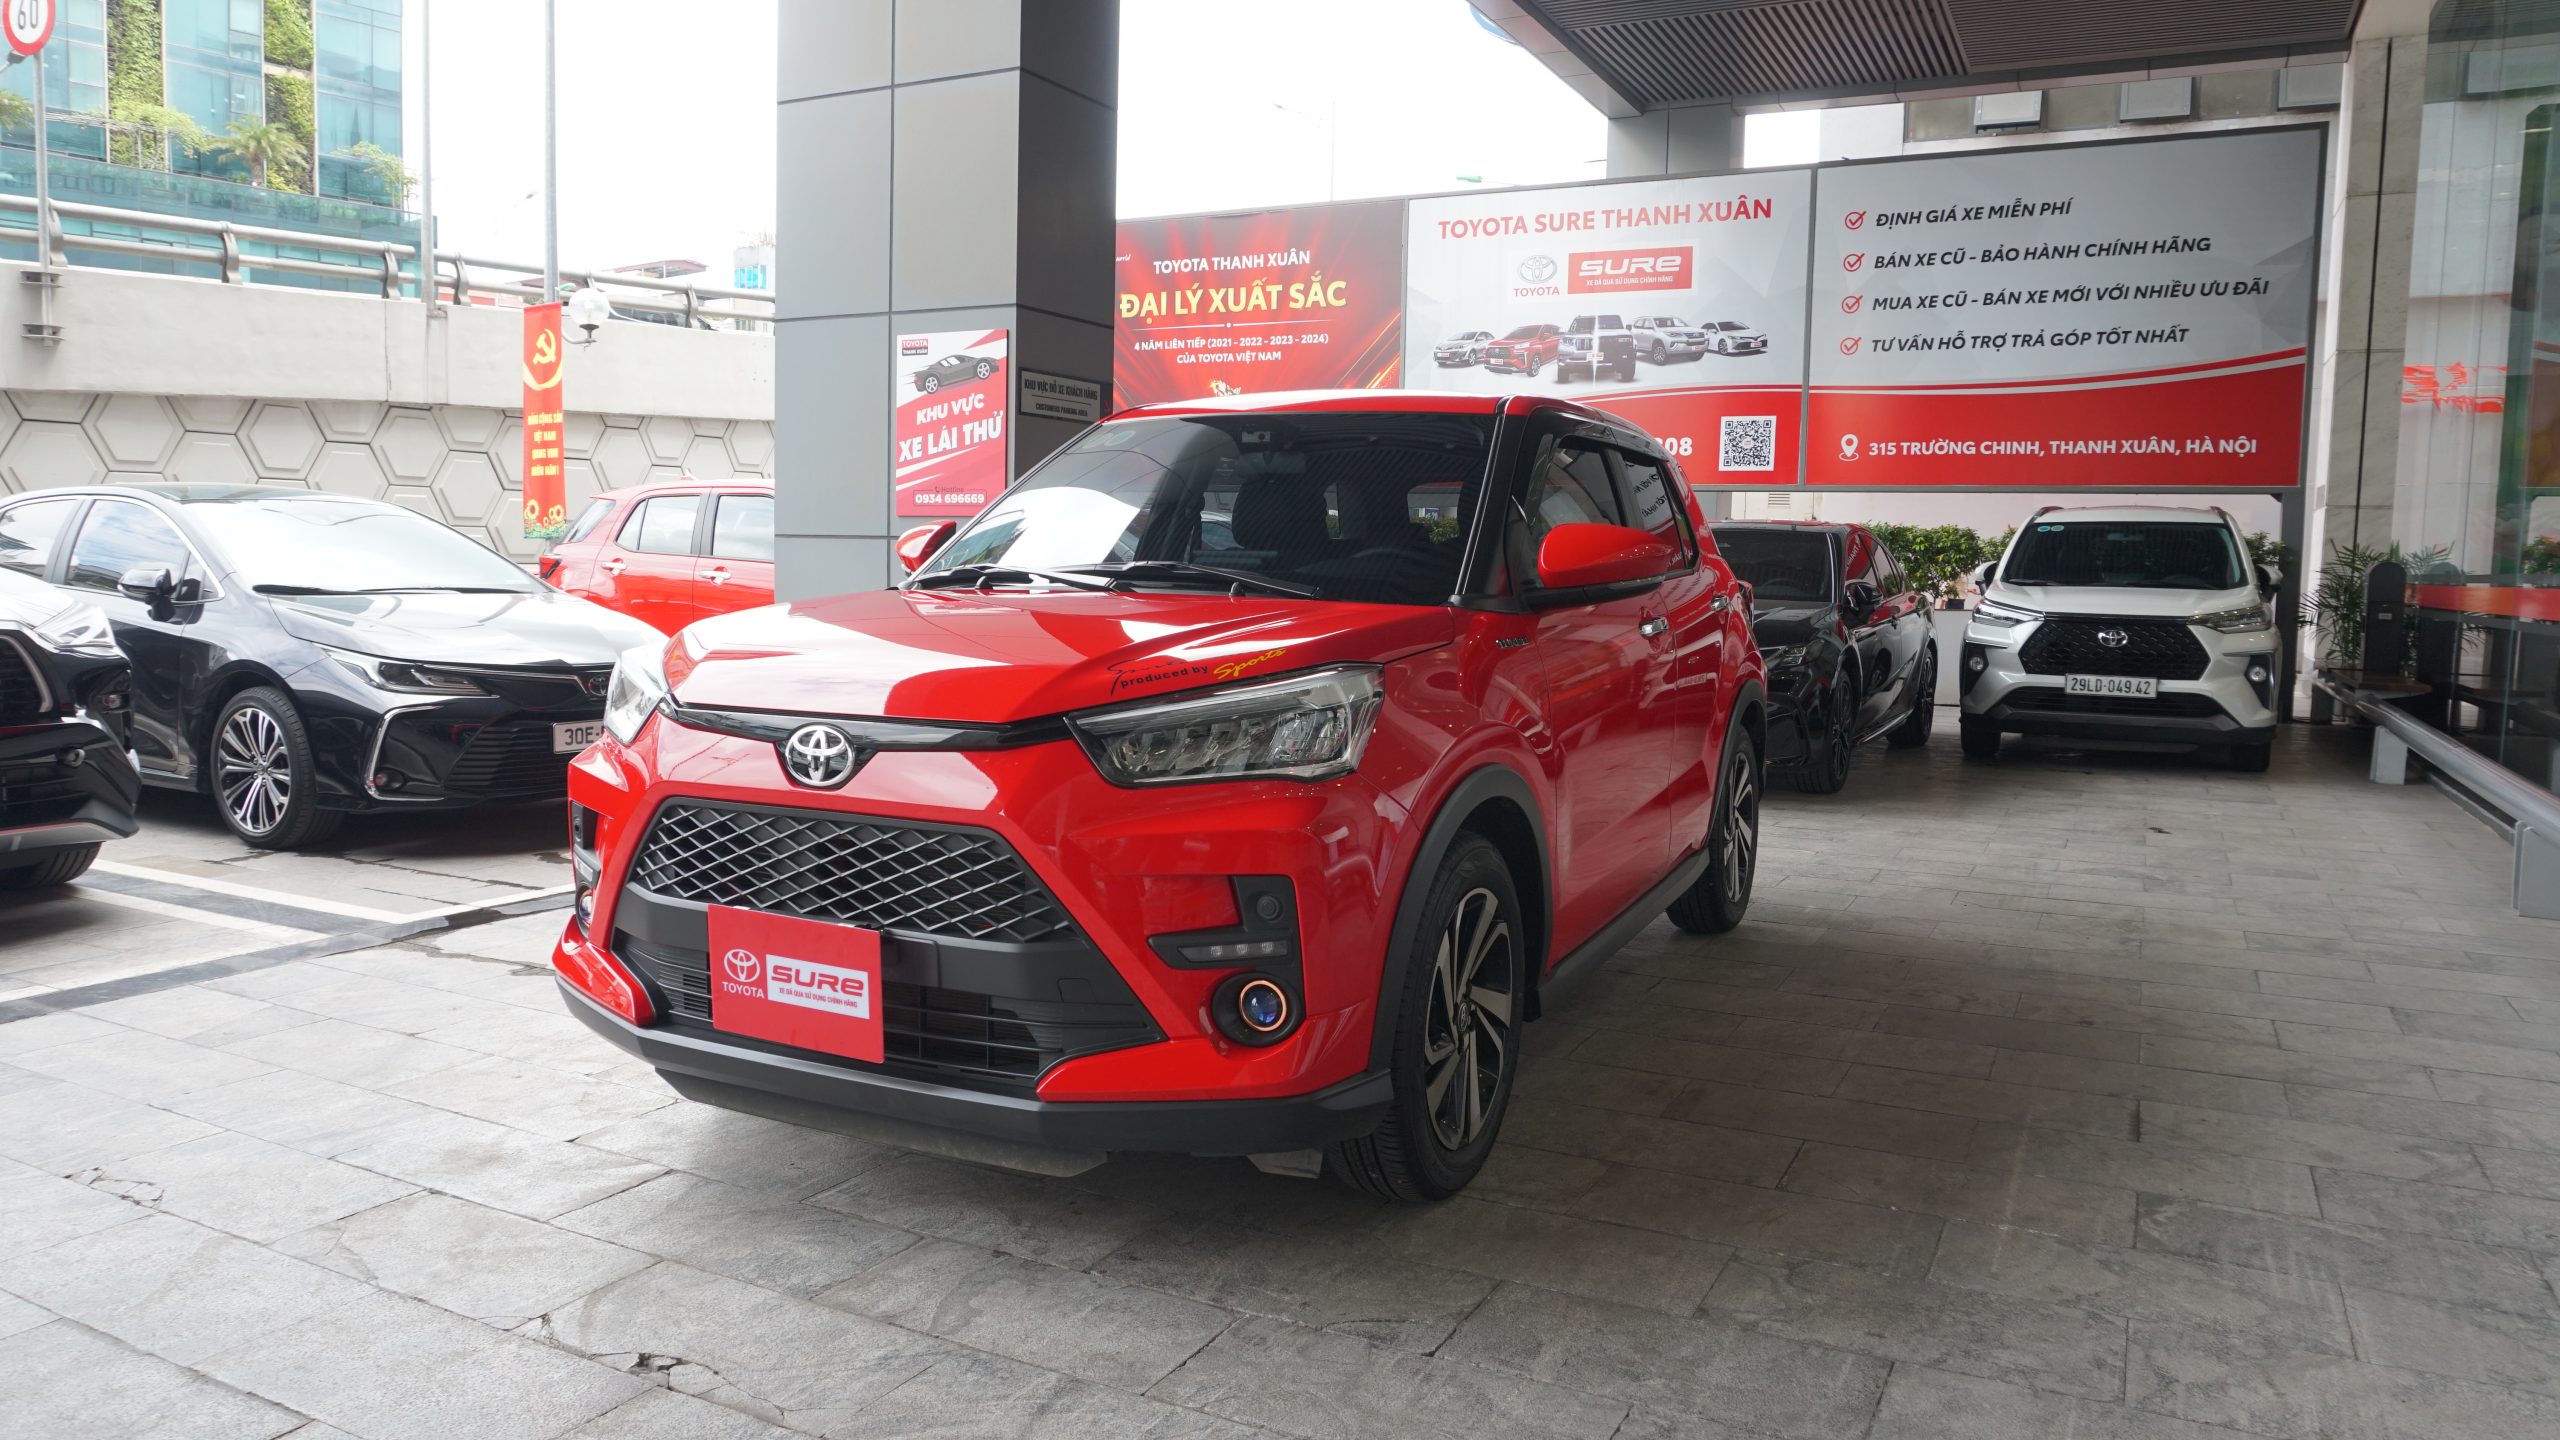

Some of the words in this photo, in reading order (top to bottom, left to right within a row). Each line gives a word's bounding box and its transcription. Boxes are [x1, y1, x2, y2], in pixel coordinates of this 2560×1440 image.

[18, 0, 39, 29] 60
[1438, 215, 1529, 239] TOYOTA
[1534, 209, 1596, 234] SURE
[1601, 204, 1691, 229] THANH
[1697, 194, 1773, 223] XUÂN
[1875, 209, 1921, 229] ĐỊNH
[1925, 204, 1959, 224] GIÁ
[1961, 204, 1985, 222] XE
[1988, 197, 2037, 220] MIỄN
[2040, 197, 2074, 217] PHÍ
[1153, 257, 1209, 275] TOYOTA
[1212, 253, 1264, 270] THANH
[1267, 248, 1311, 268] XUÂN
[1873, 249, 1912, 270] BÁN
[1914, 251, 1938, 268] XE
[1940, 245, 1967, 266] CŨ
[1980, 242, 2020, 264] BẢO
[2023, 239, 2081, 262] HÀNH
[2084, 236, 2148, 259] CHÍNH
[2151, 236, 2212, 255] HÃNG
[1120, 291, 1167, 324] ĐẠI
[1175, 282, 1204, 315] LÝ
[1208, 277, 1283, 313] XUẤT
[1289, 270, 1347, 309] SẮC
[1513, 286, 1560, 297] TOYOTA
[1872, 295, 1913, 312] MUA
[1916, 293, 1939, 309] XE
[1941, 287, 1969, 308] CŨ
[1982, 285, 2022, 306] BÁN
[2024, 289, 2049, 305] XE
[2052, 283, 2093, 303] MỚI
[2096, 281, 2130, 301] VỚI
[2133, 278, 2197, 299] NHIỀU
[2200, 279, 2231, 297] ƯU
[2232, 278, 2270, 296] ĐÃI
[902, 339, 928, 348] TOYOTA
[1134, 341, 1140, 351] 4
[1141, 338, 1163, 350] NĂM
[1164, 337, 1185, 350] LIÊN
[1185, 335, 1206, 349] TIẾP
[1207, 336, 1232, 349] (2021
[1240, 336, 1263, 347] 2022
[1270, 334, 1293, 345] 2023
[1301, 333, 1329, 345] 2024)
[1872, 335, 1897, 353] TƯ
[1897, 329, 1934, 352] VẤN
[1937, 328, 1967, 350] HỖ
[1970, 333, 2007, 352] TRỢ
[2011, 329, 2047, 349] TRẢ
[2050, 327, 2093, 347] GÓP
[2095, 324, 2133, 346] TỐT
[2135, 322, 2190, 343] NHẤT
[1176, 351, 1197, 364] CỦA
[1198, 351, 1234, 363] TOYOTA
[1235, 350, 1257, 364] VIỆT
[1258, 351, 1281, 362] NAM
[1024, 379, 1036, 391] KHU
[1037, 380, 1048, 394] VỰC
[1057, 384, 1065, 395] XE
[916, 403, 947, 425] KHU
[951, 393, 985, 415] VỰC
[898, 434, 923, 463] XE
[927, 425, 958, 455] LÁI
[962, 410, 1004, 446] THỬ
[1868, 442, 1897, 456] 315
[1900, 436, 1977, 456] TRƯỜNG
[1980, 440, 2046, 458] CHINH,
[2049, 439, 2118, 455] THANH
[2121, 436, 2181, 458] XUÂN,
[2185, 435, 2216, 455] HÀ
[2219, 436, 2257, 458] NỘI
[915, 494, 942, 504] 0934
[944, 494, 985, 504] 696669
[941, 485, 964, 493] Hotline
[1120, 667, 1189, 689] produced
[1192, 665, 1209, 674] by
[1213, 648, 1287, 680] Sports
[2070, 677, 2151, 695] 29LD-049.42
[564, 727, 604, 745] 30E-
[722, 981, 765, 999] TOYOTA
[779, 987, 786, 995] XE
[794, 990, 804, 998] QUA
